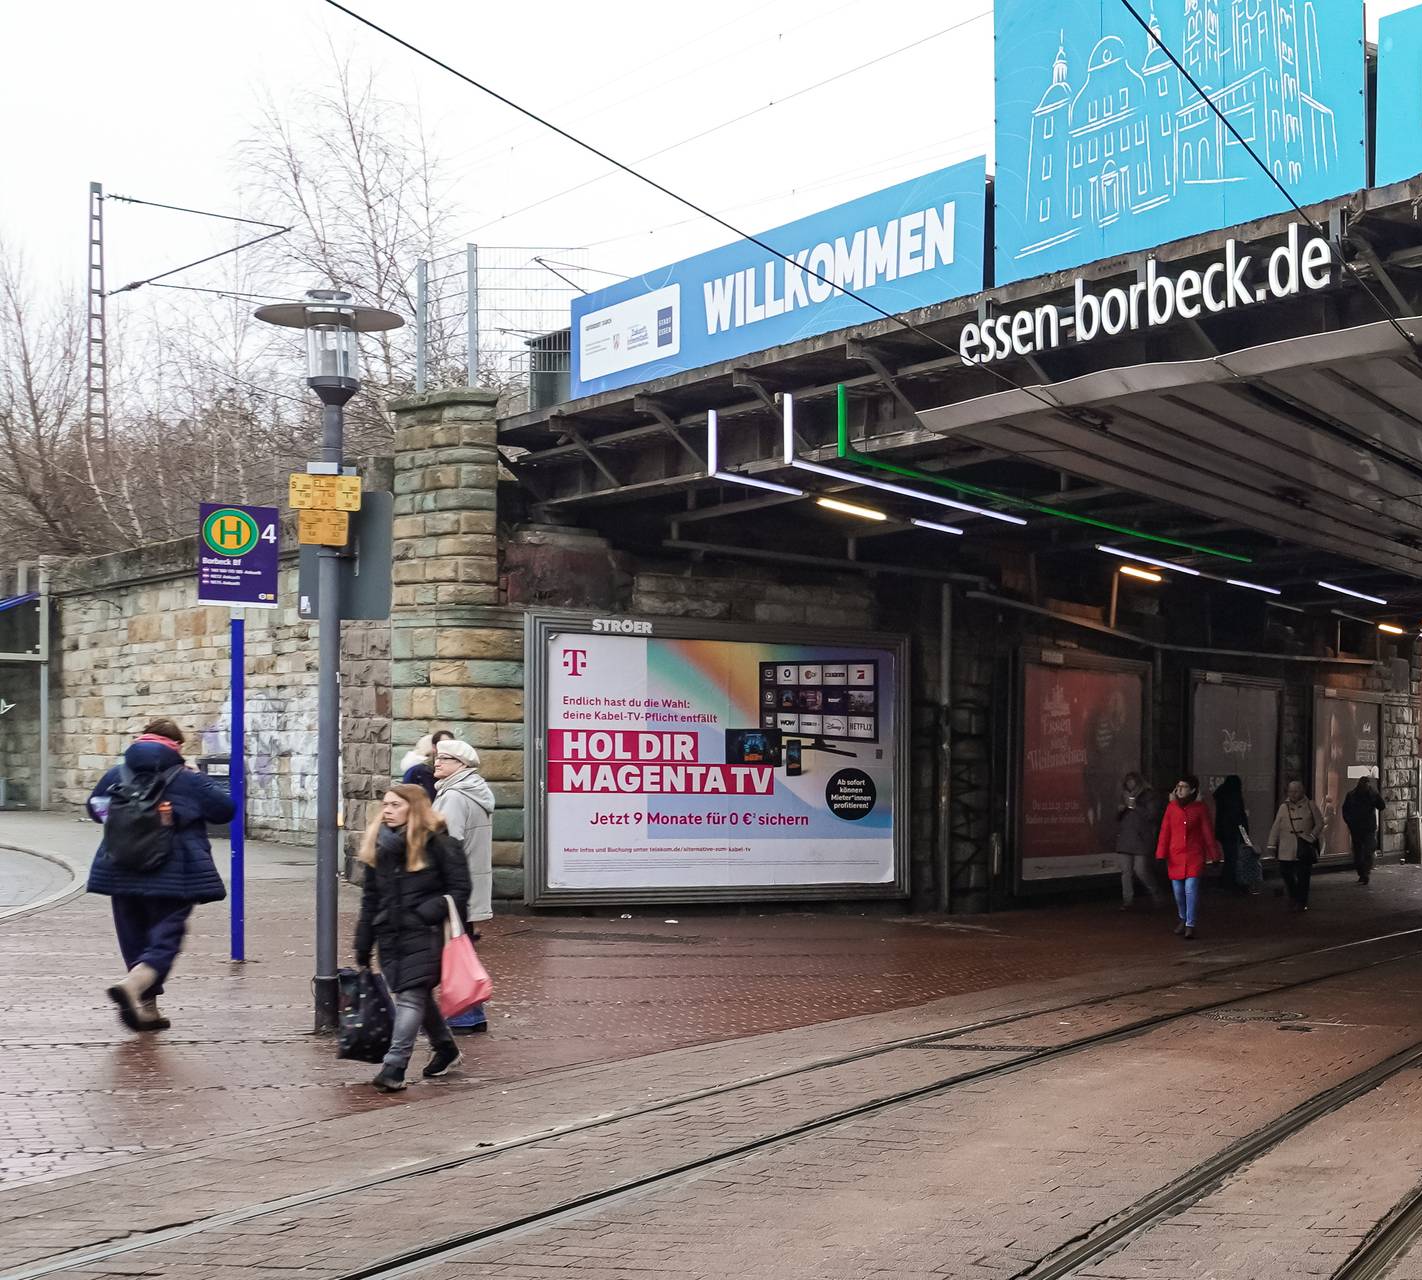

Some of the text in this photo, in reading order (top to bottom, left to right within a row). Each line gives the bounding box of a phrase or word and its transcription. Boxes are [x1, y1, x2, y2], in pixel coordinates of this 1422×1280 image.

[704, 201, 956, 336] WILLKOMMEN
[959, 222, 1332, 367] essen-borbeck.de
[220, 519, 242, 546] H
[260, 523, 277, 544] 4
[591, 618, 653, 634] STRÖER
[563, 696, 691, 709] Endlich hast du die Wahl:
[562, 711, 718, 723] deine Kabel-TV-Pflicht entfällt
[850, 723, 873, 732] NETFLIX
[562, 731, 695, 761] HOL DIR
[562, 764, 774, 794] MAGENTA TV
[833, 802, 869, 810] profitieren!
[590, 812, 630, 825] Jetzt
[633, 812, 643, 825] 9
[647, 812, 703, 825] Monate
[706, 812, 727, 825] für
[729, 812, 739, 826] 0
[758, 812, 809, 826] sichern
